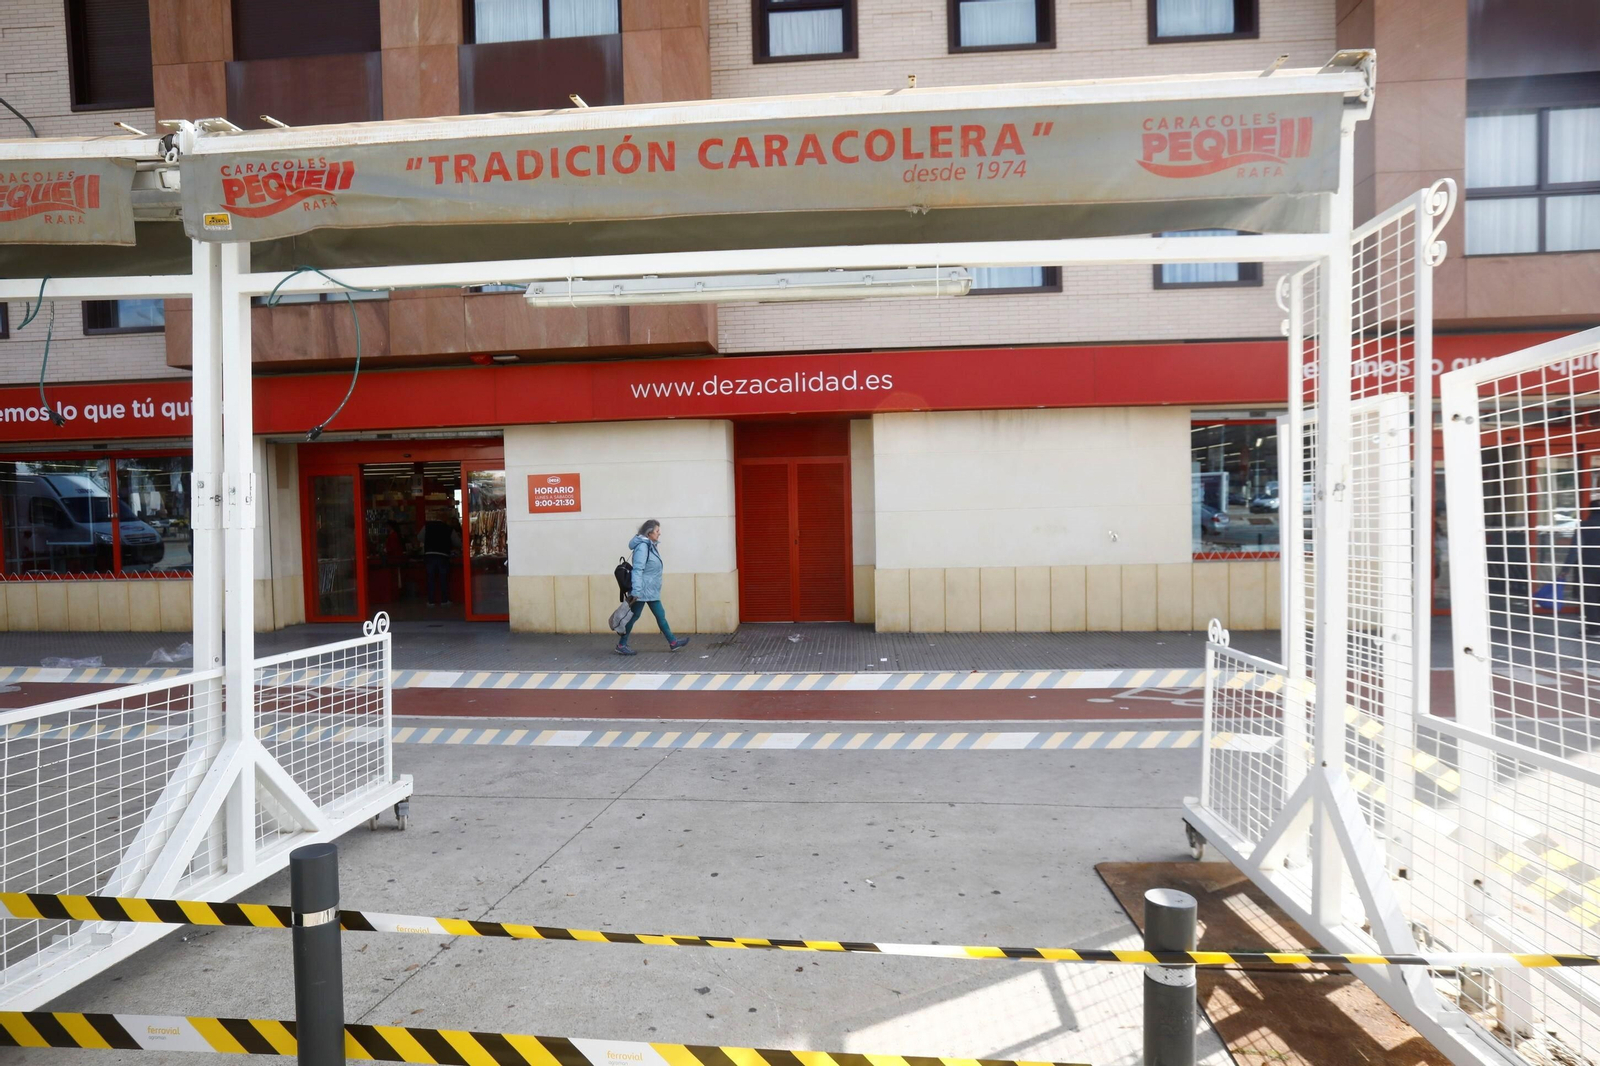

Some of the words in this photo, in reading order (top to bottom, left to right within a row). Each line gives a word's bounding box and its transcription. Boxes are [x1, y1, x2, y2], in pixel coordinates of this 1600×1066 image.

[1142, 112, 1277, 131] CARACOLES
[220, 157, 327, 177] CARACOLES
[902, 162, 967, 183] desde
[976, 159, 1027, 180] 1974
[1236, 166, 1284, 179] RAFA
[303, 197, 338, 212] RAFA
[44, 214, 85, 225] RAFA
[630, 370, 893, 398] www.dezacalidad.es
[56, 401, 78, 421] lo
[83, 402, 126, 423] que
[131, 397, 155, 418] tú
[534, 486, 574, 494] HORARIO
[534, 499, 575, 507] 9:00-21:30
[147, 1025, 180, 1035] ferrovial
[607, 1050, 643, 1061] ferrovial
